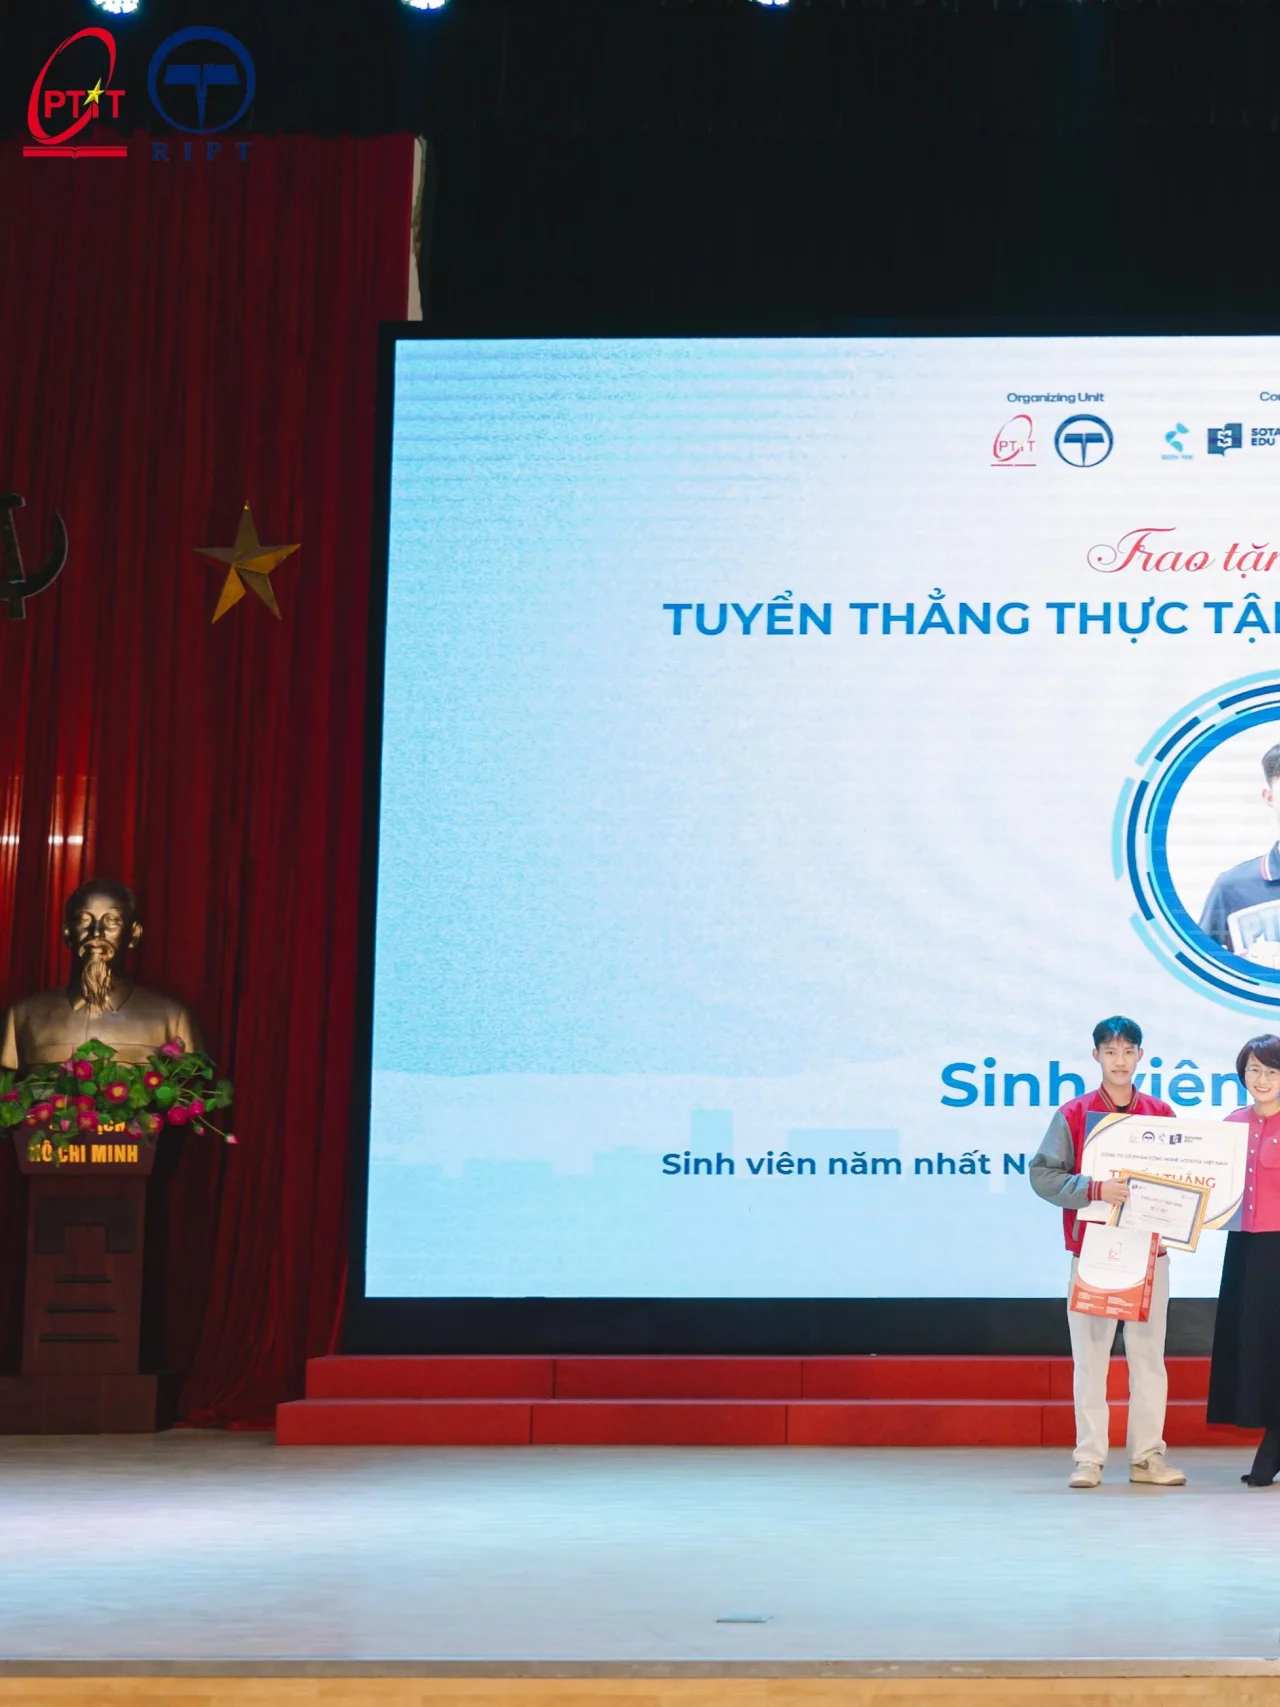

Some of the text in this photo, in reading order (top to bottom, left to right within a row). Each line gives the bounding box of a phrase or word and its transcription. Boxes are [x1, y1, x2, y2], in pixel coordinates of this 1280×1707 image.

[1007, 392, 1104, 404] Organizing Unit
[1251, 437, 1275, 446] EDU
[1087, 526, 1216, 573] Trao
[663, 590, 832, 636] TUYỂN
[849, 588, 1030, 635] THẲNG
[1046, 597, 1188, 644] THỰC
[940, 1056, 1085, 1107] Sinh
[58, 1144, 86, 1163] CHI
[91, 1144, 139, 1163] MINH
[661, 1152, 734, 1175] Sinh
[745, 1152, 816, 1175] viên
[828, 1152, 902, 1175] năm
[914, 1149, 991, 1175] nhất
